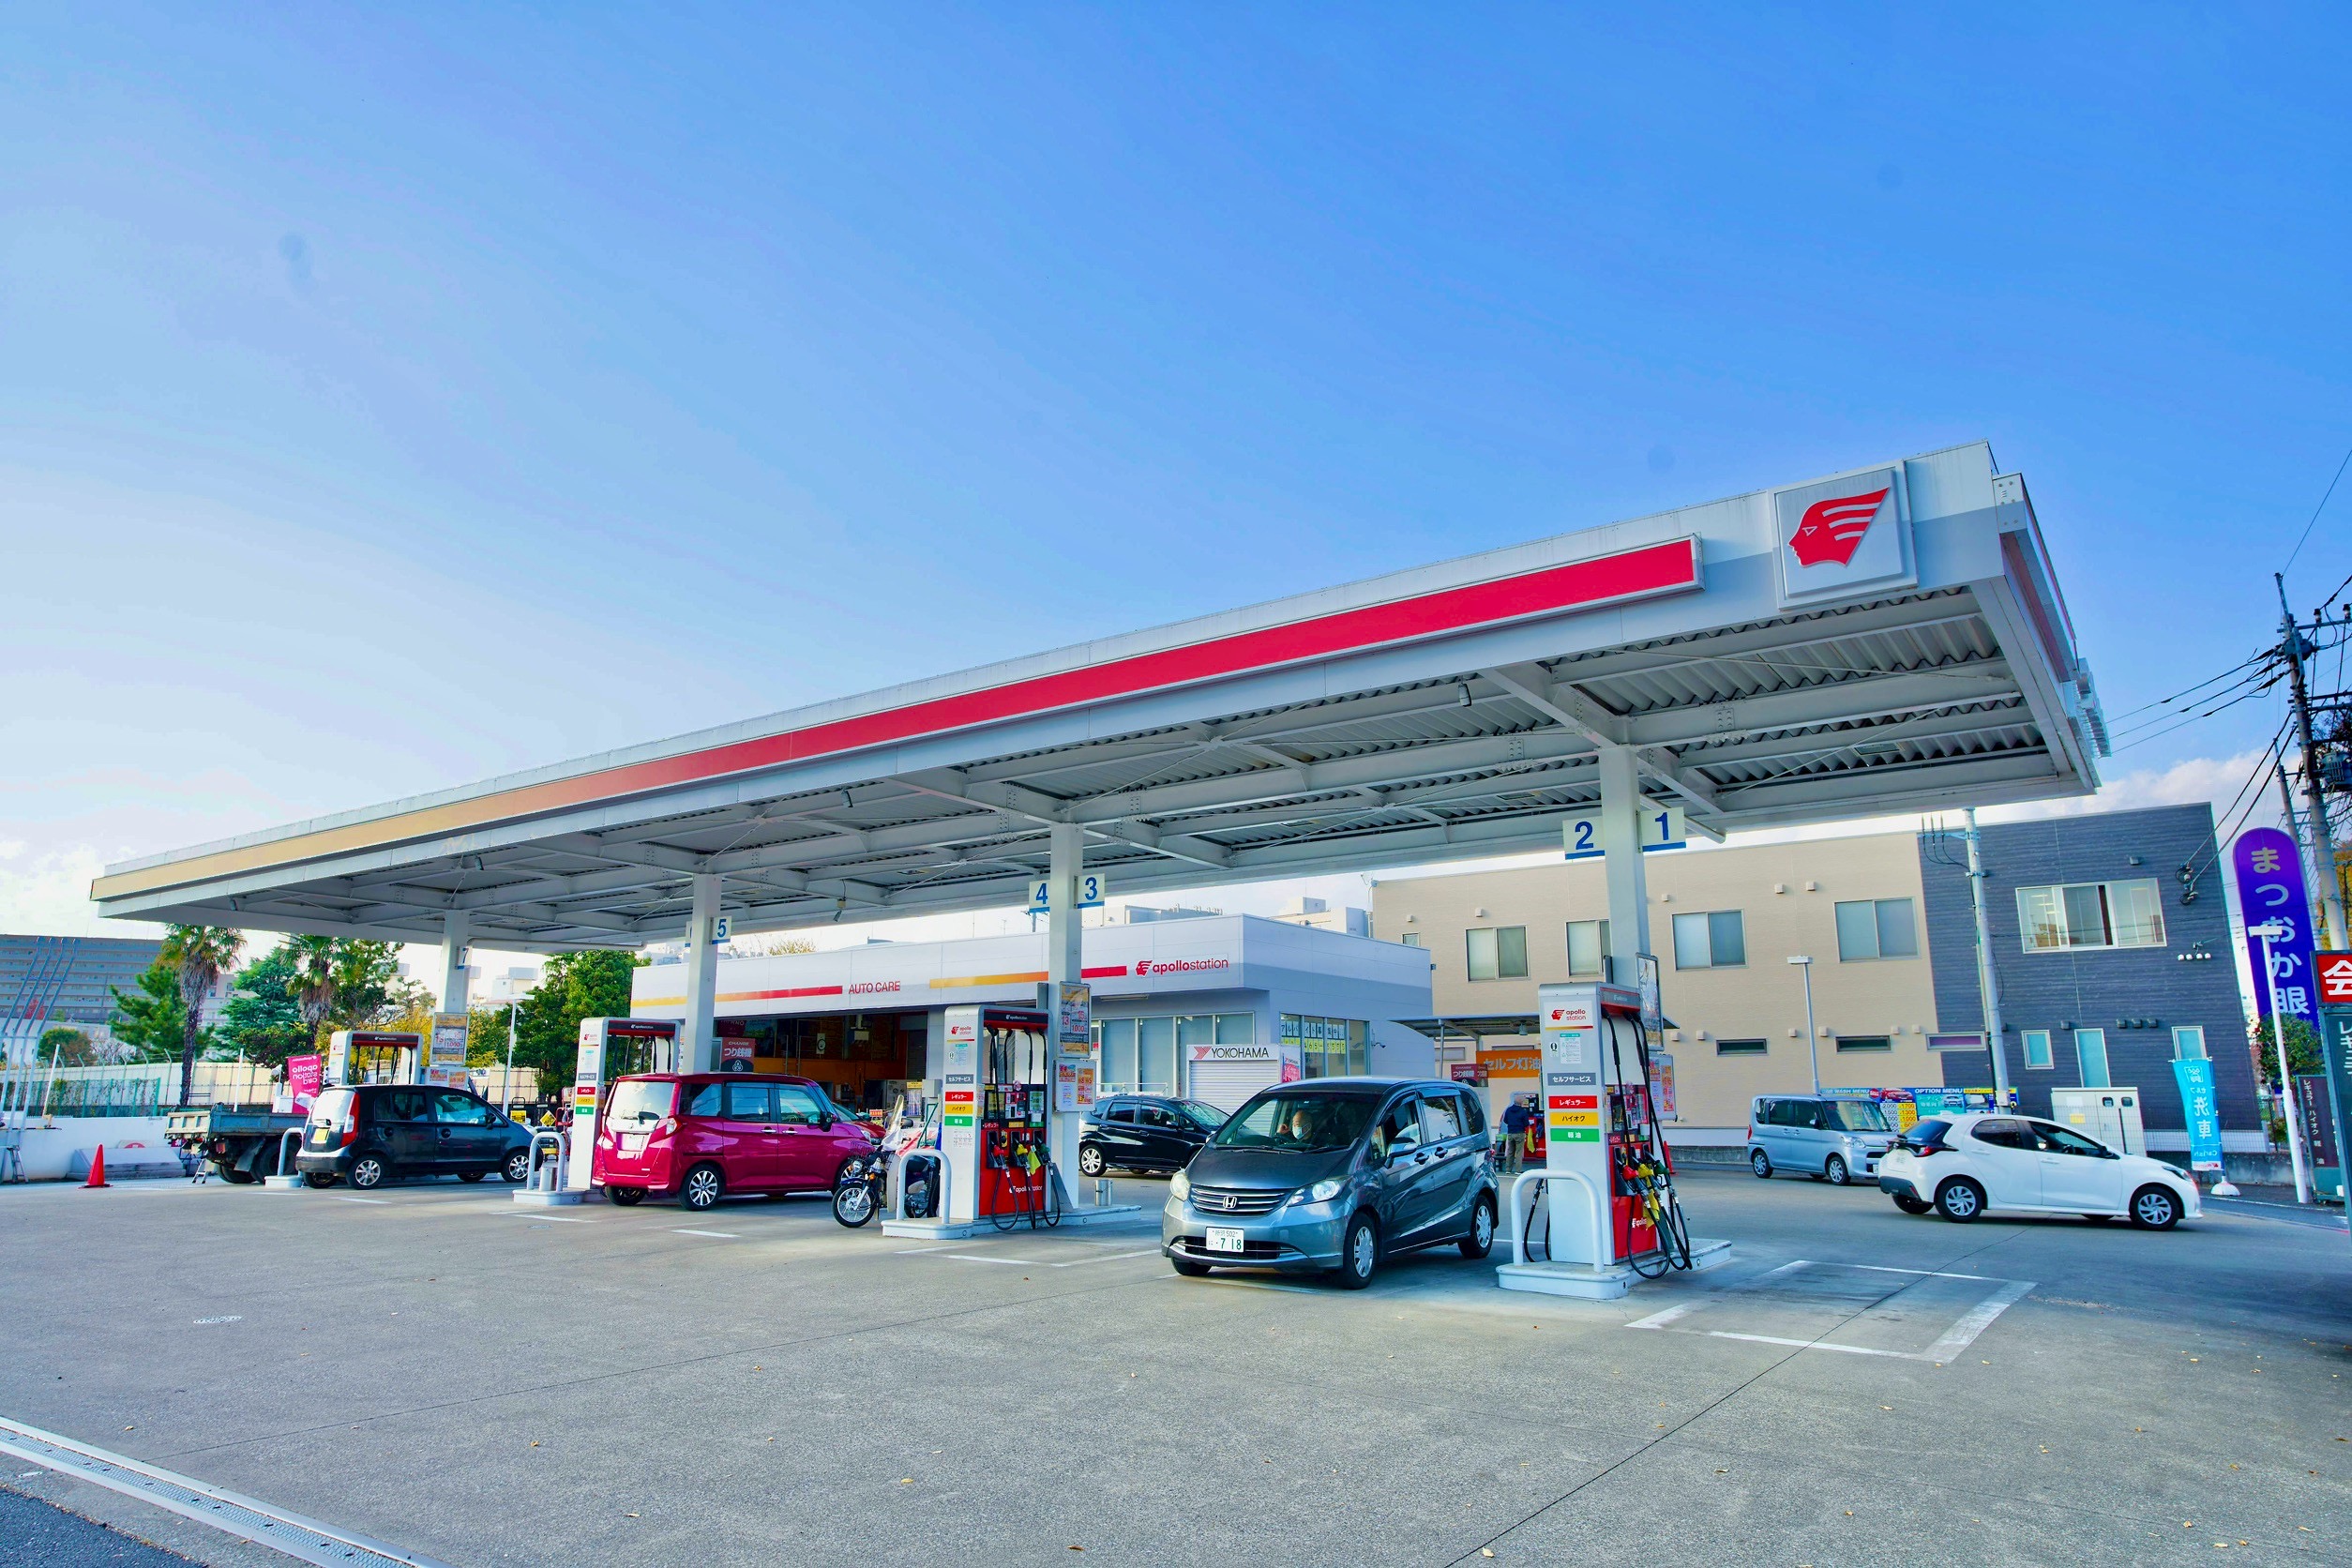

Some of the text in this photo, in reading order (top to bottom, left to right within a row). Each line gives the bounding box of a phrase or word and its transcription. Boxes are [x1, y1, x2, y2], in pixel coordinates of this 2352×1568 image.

[1575, 821, 1594, 851] 2
[1654, 811, 1669, 841] 1
[1035, 882, 1048, 905] 4
[1084, 876, 1098, 900] 3
[717, 918, 727, 938] 5
[462, 947, 470, 964] 7
[1153, 957, 1229, 975] apollostation
[849, 980, 900, 994] AUTO CARE
[1212, 1047, 1269, 1060] YOKOHAMA
[1484, 1057, 1542, 1071] セルフ灯油
[2303, 1078, 2314, 1107] レギュラー
[2309, 1110, 2319, 1136] ハイオク
